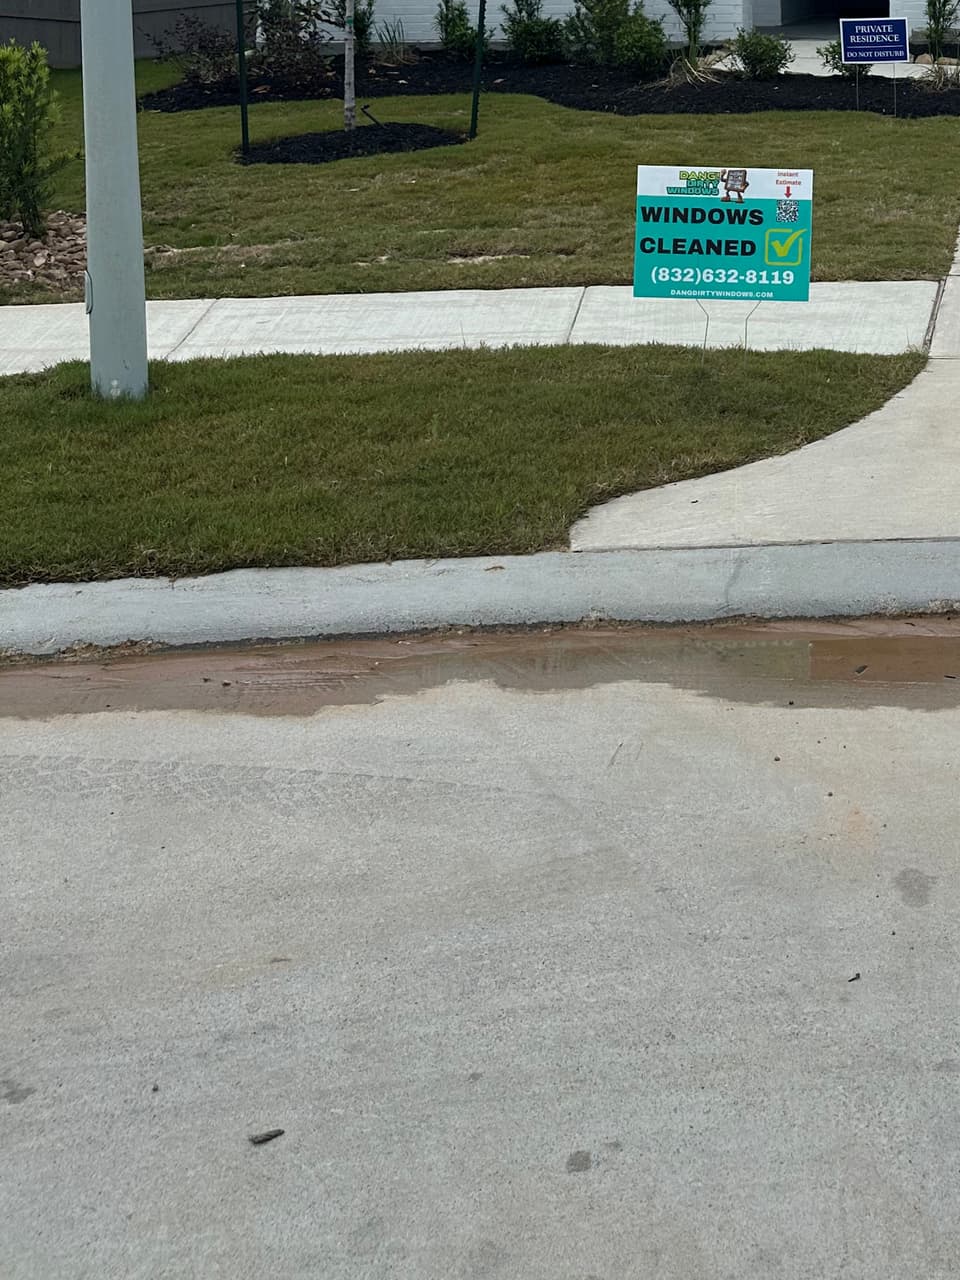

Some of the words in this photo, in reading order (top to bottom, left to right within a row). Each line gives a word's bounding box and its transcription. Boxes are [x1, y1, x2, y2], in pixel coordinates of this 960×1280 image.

[855, 24, 894, 34] PRIVATE
[849, 34, 900, 43] RESIDENCE
[687, 180, 720, 188] DIRTY
[666, 187, 720, 196] WINDOWS
[641, 206, 764, 225] WINDOWS
[639, 237, 757, 257] CLEANED
[651, 266, 794, 285] (832)632-8119
[670, 289, 774, 298] DANGDIRTYWINDOWS.COM
